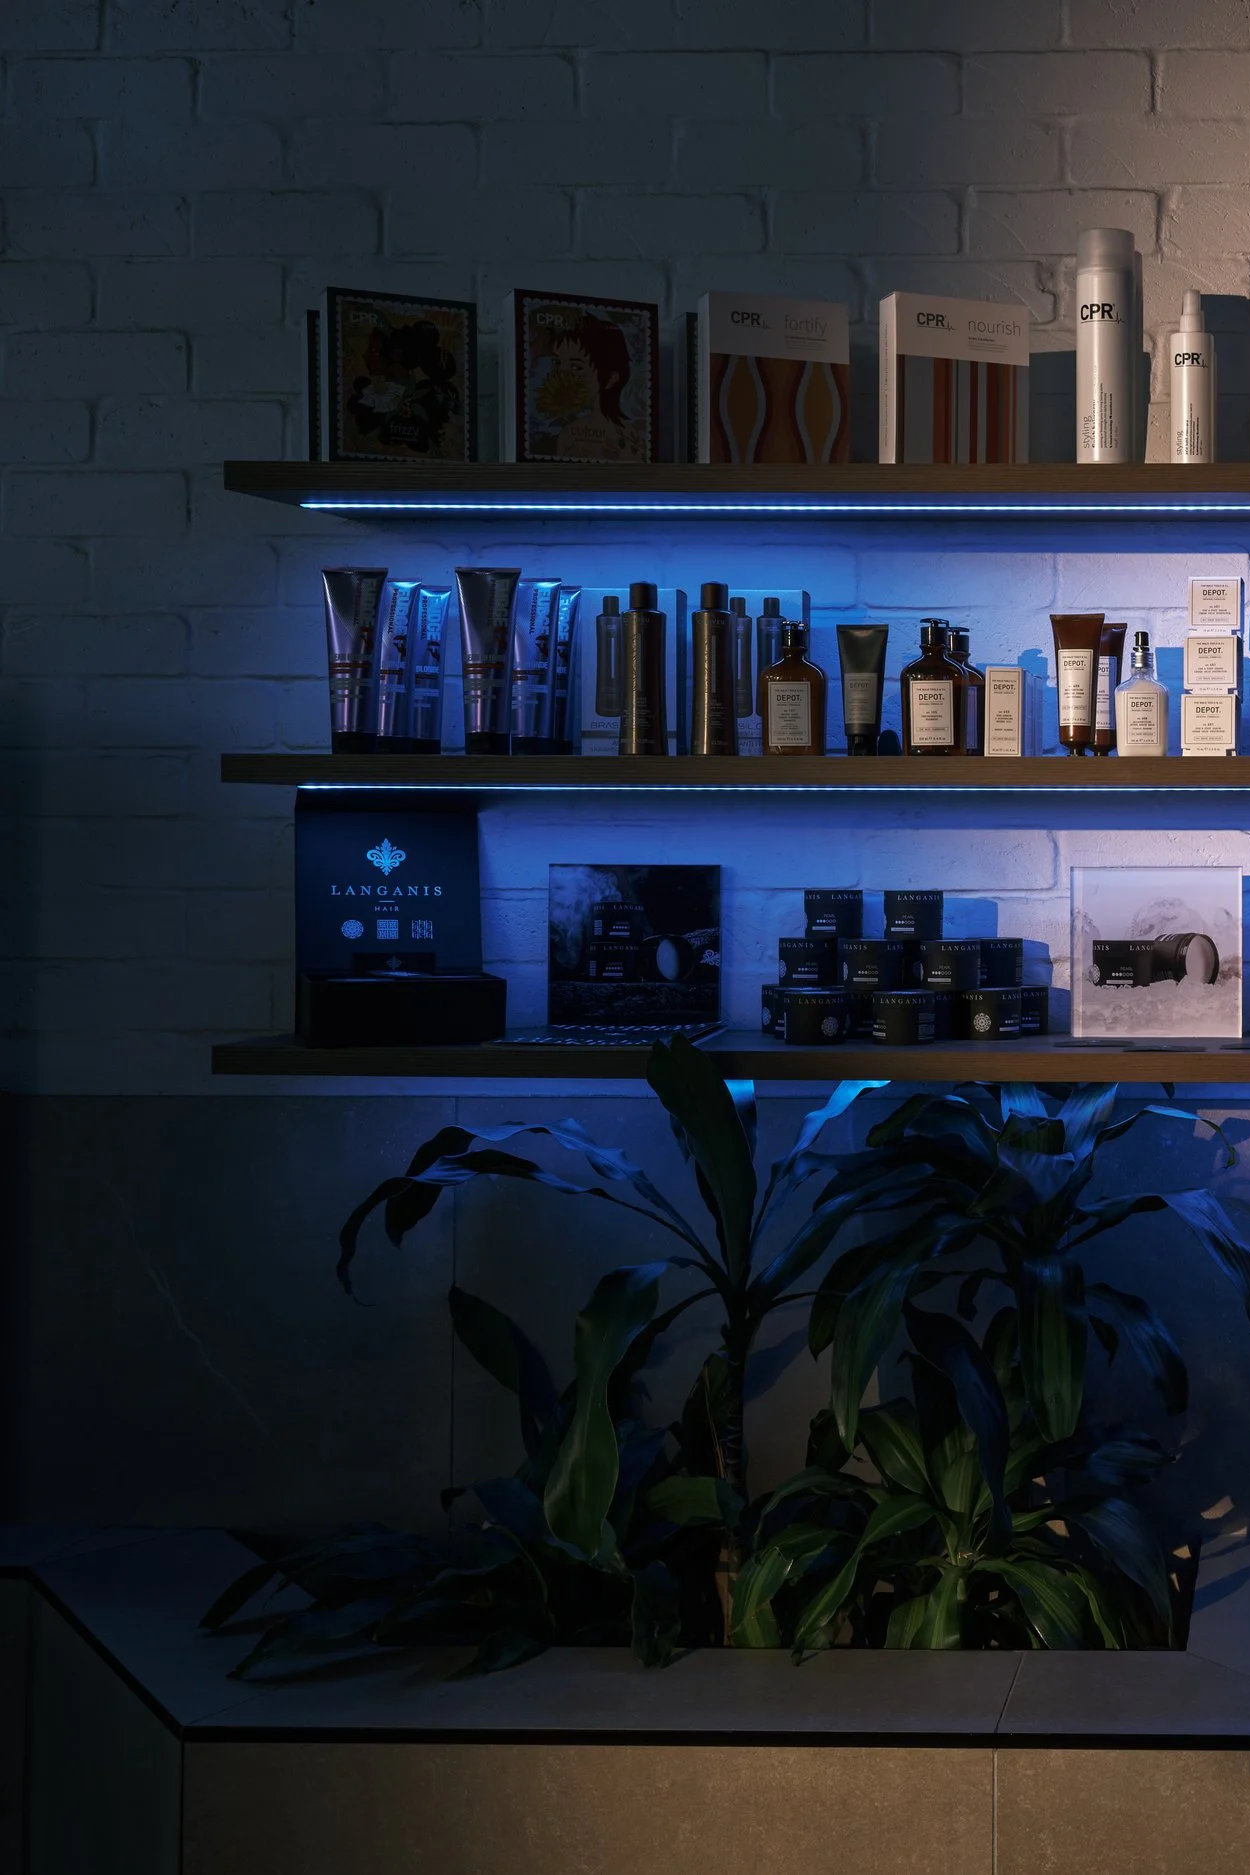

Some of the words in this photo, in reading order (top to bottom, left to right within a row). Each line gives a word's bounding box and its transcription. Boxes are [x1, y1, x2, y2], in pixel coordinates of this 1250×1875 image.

[348, 311, 379, 326] CPR
[536, 312, 566, 327] CPR
[730, 310, 762, 327] CPR
[916, 311, 946, 328] CPR
[1080, 303, 1114, 321] CPR
[784, 313, 828, 337] fortify
[967, 317, 1022, 338] nourish
[1174, 352, 1201, 366] CPR
[389, 422, 420, 440] frizzy
[569, 425, 607, 440] colour
[1081, 416, 1093, 449] styling
[1175, 430, 1184, 456] styling
[388, 588, 400, 636] PROFESSIONAL
[528, 588, 539, 635] PROFESSIONAL
[590, 720, 619, 730] BRAS
[330, 885, 444, 897] LANGANIS
[1094, 944, 1110, 952] NIS
